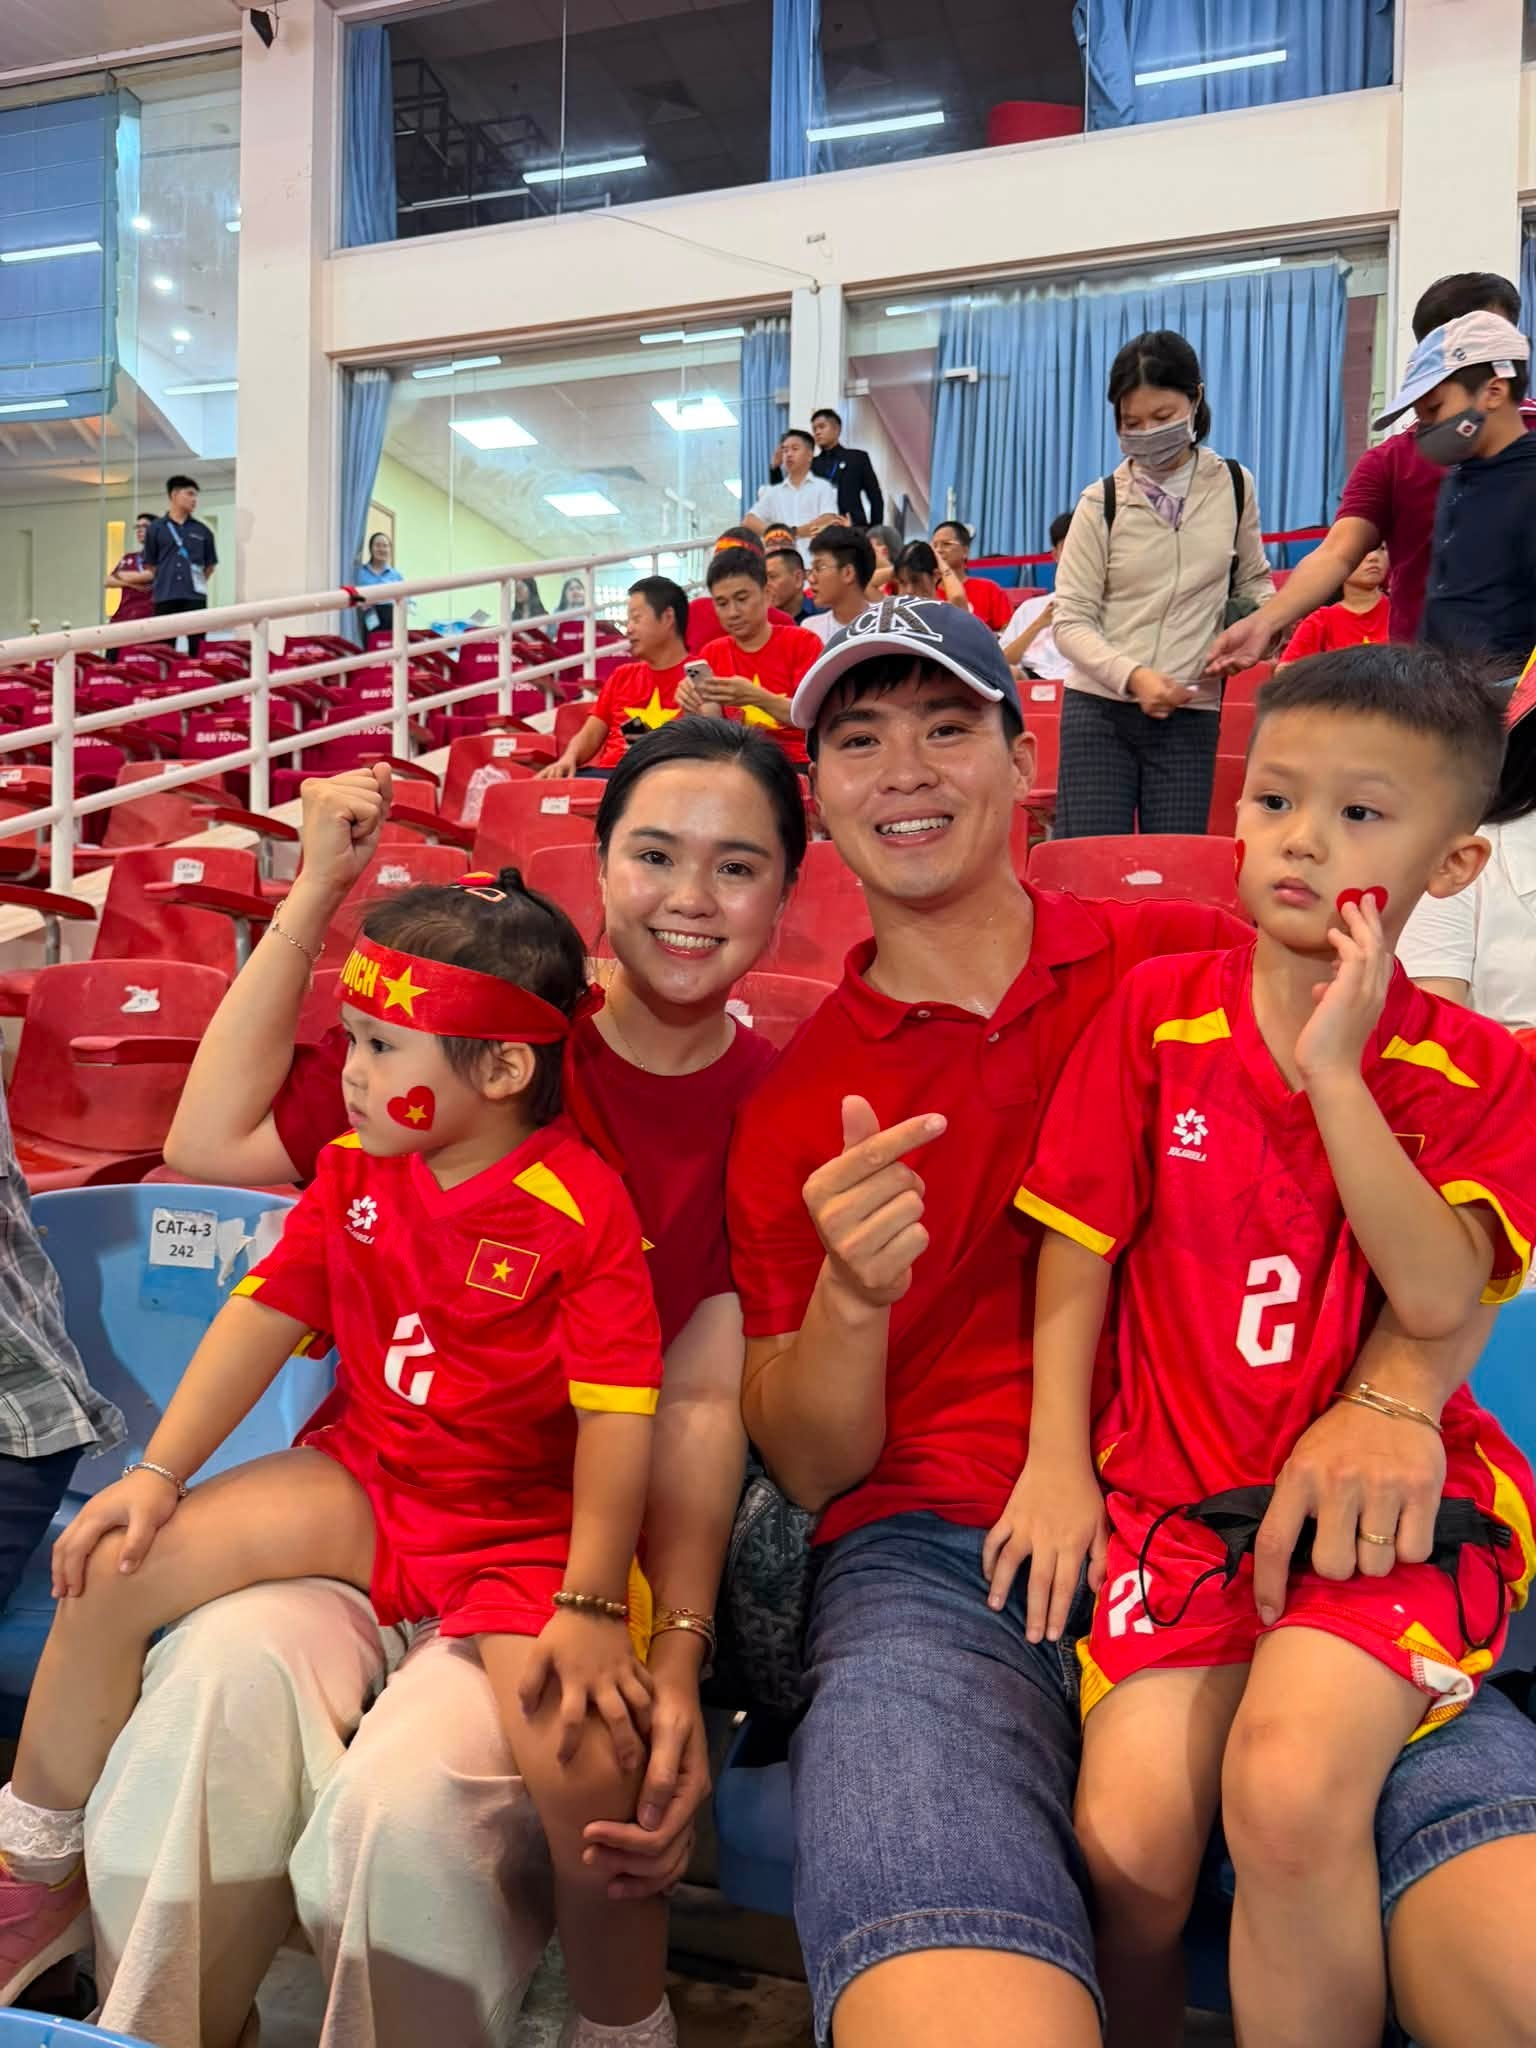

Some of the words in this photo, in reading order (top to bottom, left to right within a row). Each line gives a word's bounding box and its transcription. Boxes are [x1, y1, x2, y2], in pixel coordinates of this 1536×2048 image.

[847, 595, 943, 643] CK
[155, 1219, 212, 1237] CAT-4-3
[169, 1244, 194, 1258] 242
[1236, 1254, 1301, 1367] 2
[384, 1312, 436, 1406] 2
